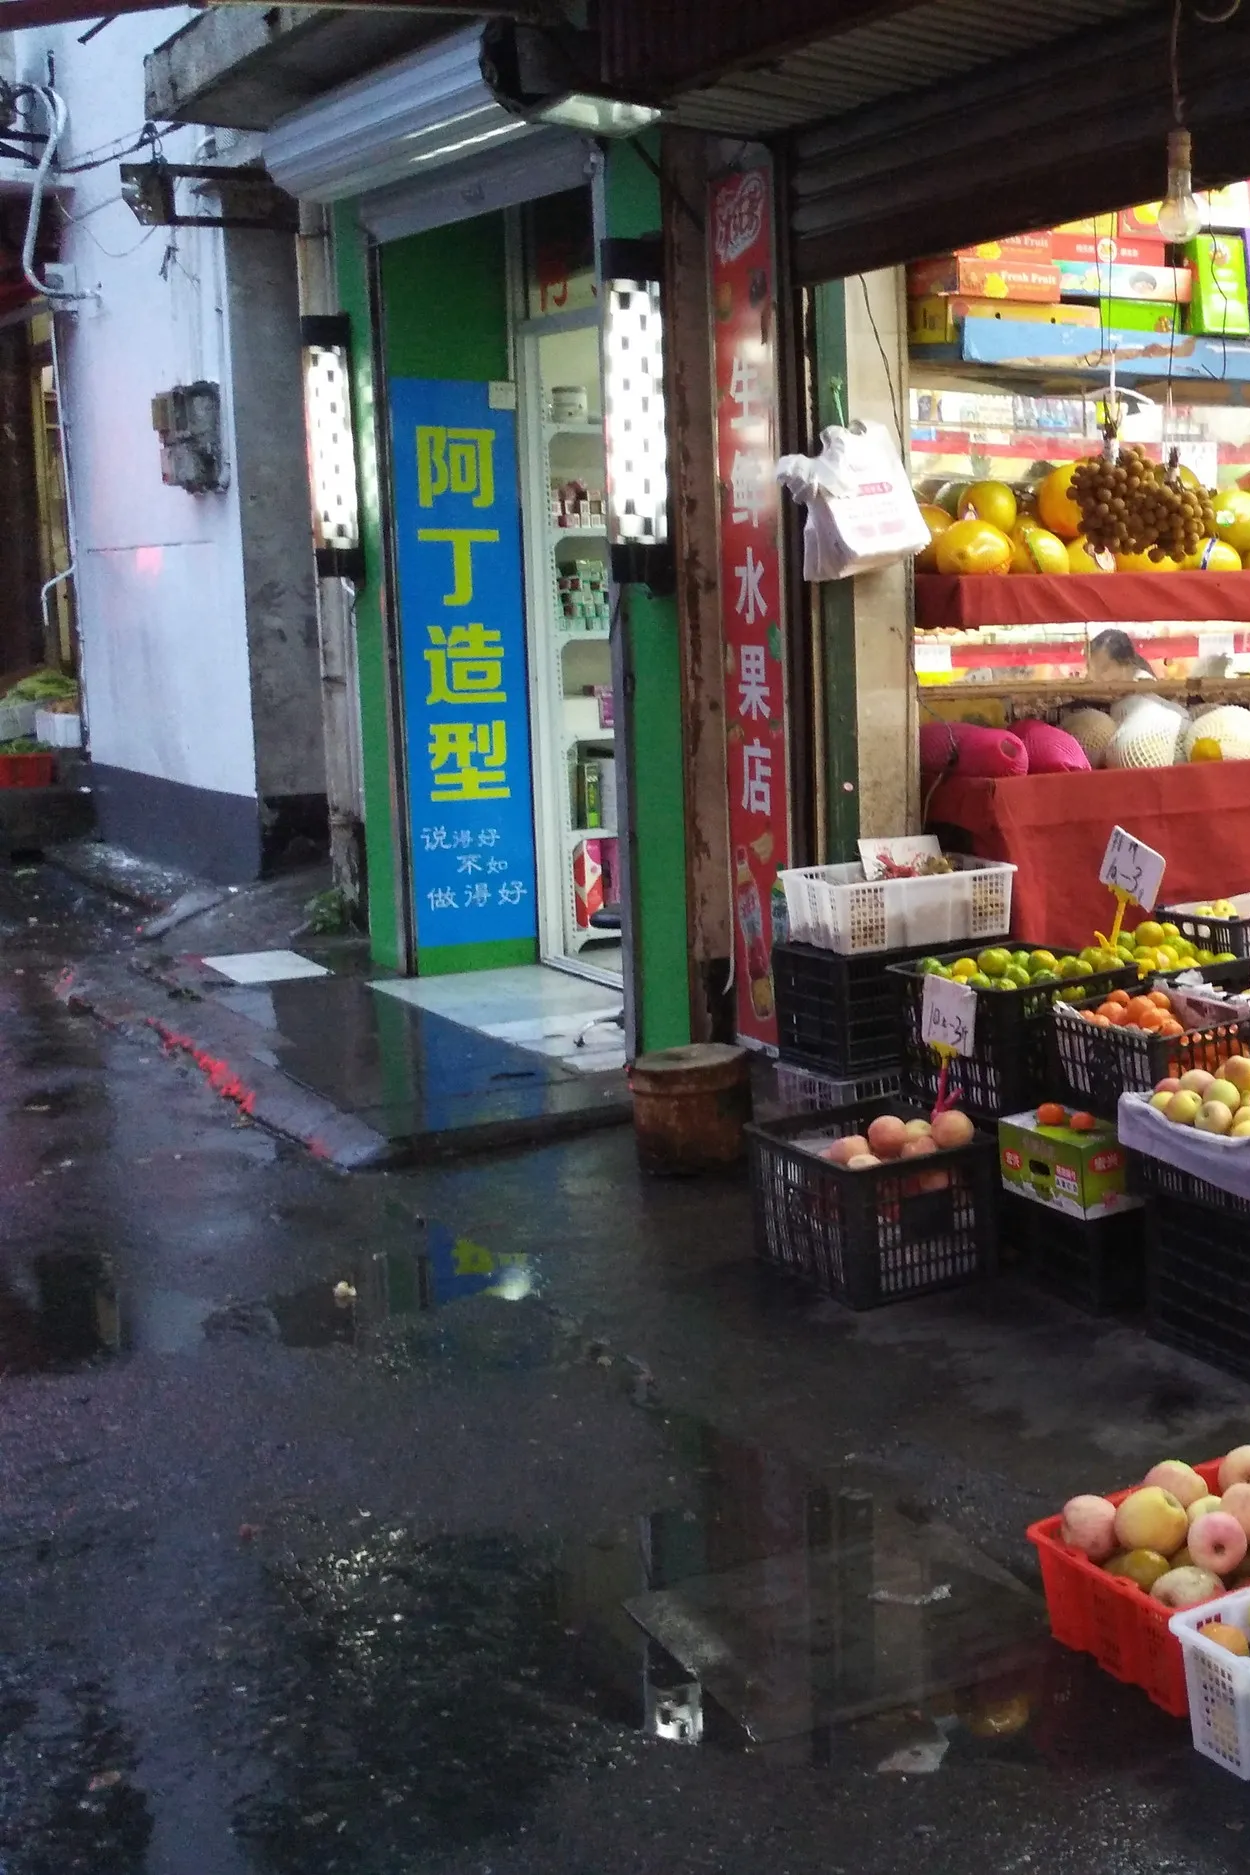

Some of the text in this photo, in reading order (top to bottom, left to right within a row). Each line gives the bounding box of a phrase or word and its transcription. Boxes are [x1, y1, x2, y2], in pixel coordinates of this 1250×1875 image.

[415, 425, 512, 803] 阿丁造型
[420, 825, 501, 852] 说得好
[456, 854, 508, 875] 不如
[427, 880, 528, 912] 做得好
